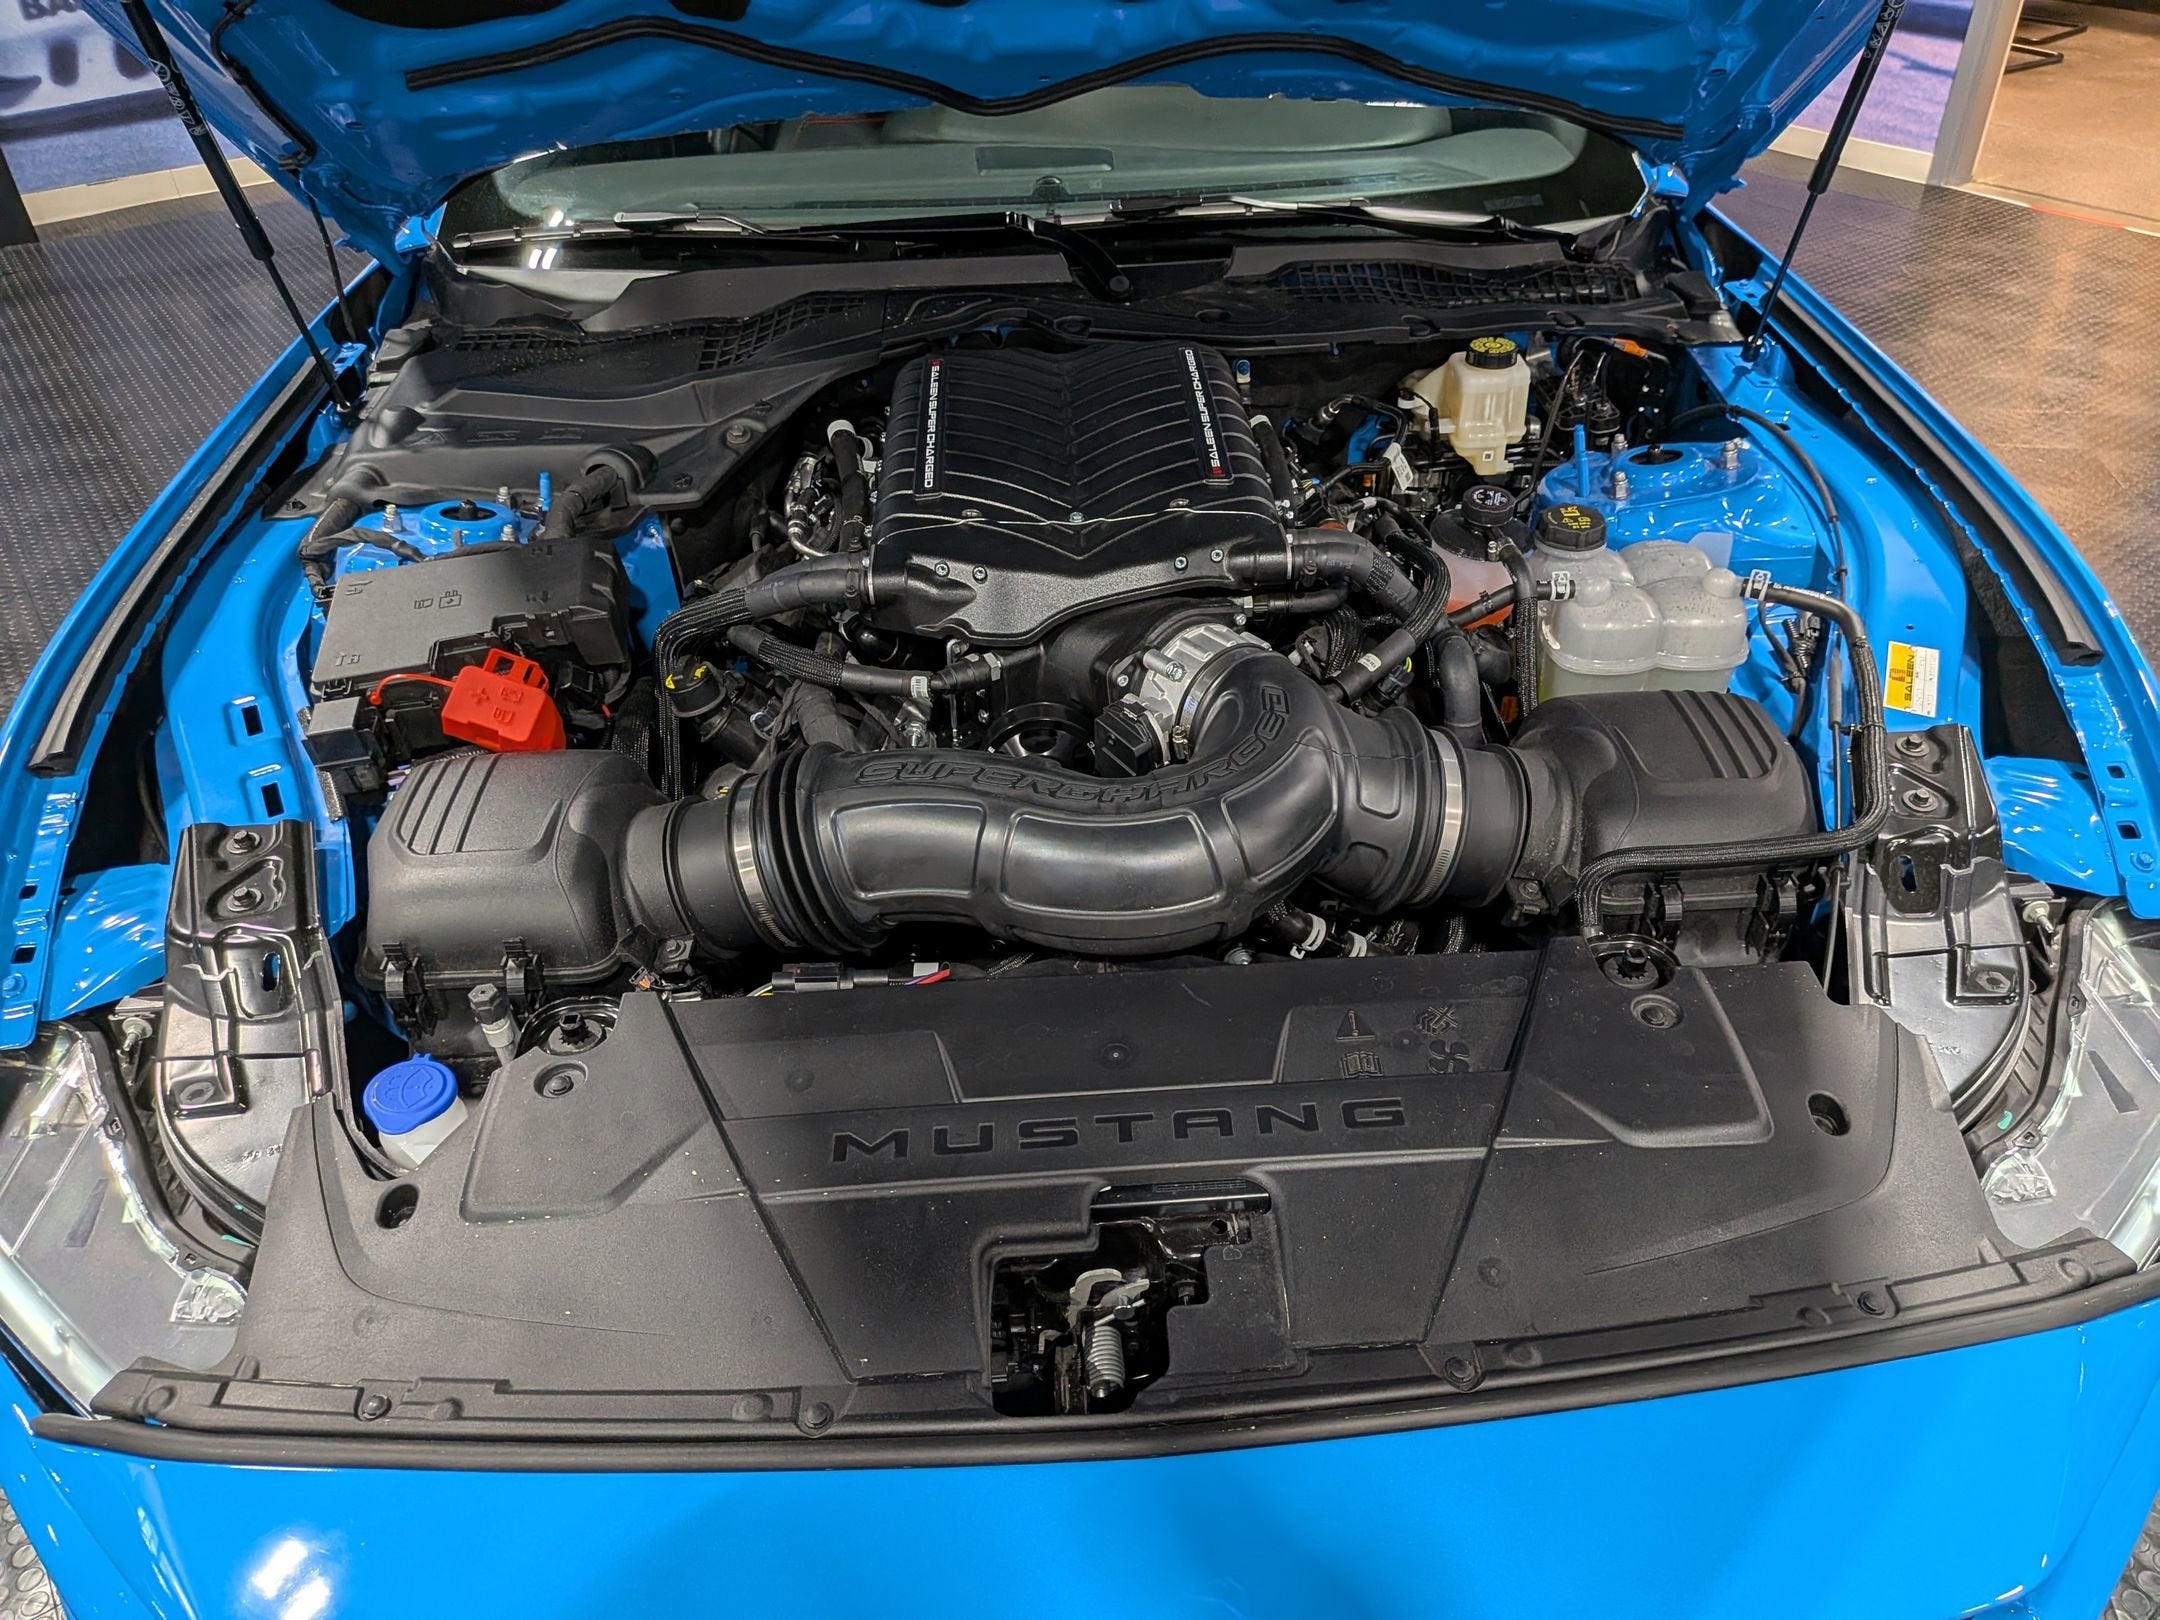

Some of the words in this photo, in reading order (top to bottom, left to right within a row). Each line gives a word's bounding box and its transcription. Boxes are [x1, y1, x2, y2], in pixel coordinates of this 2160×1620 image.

[929, 365, 940, 401] SALEEN
[1203, 422, 1221, 468] SALEEN
[1904, 654, 1915, 702] SALEEN
[854, 683, 1291, 803] SUPERCHARGED
[831, 1096, 1407, 1163] MUSTANG
